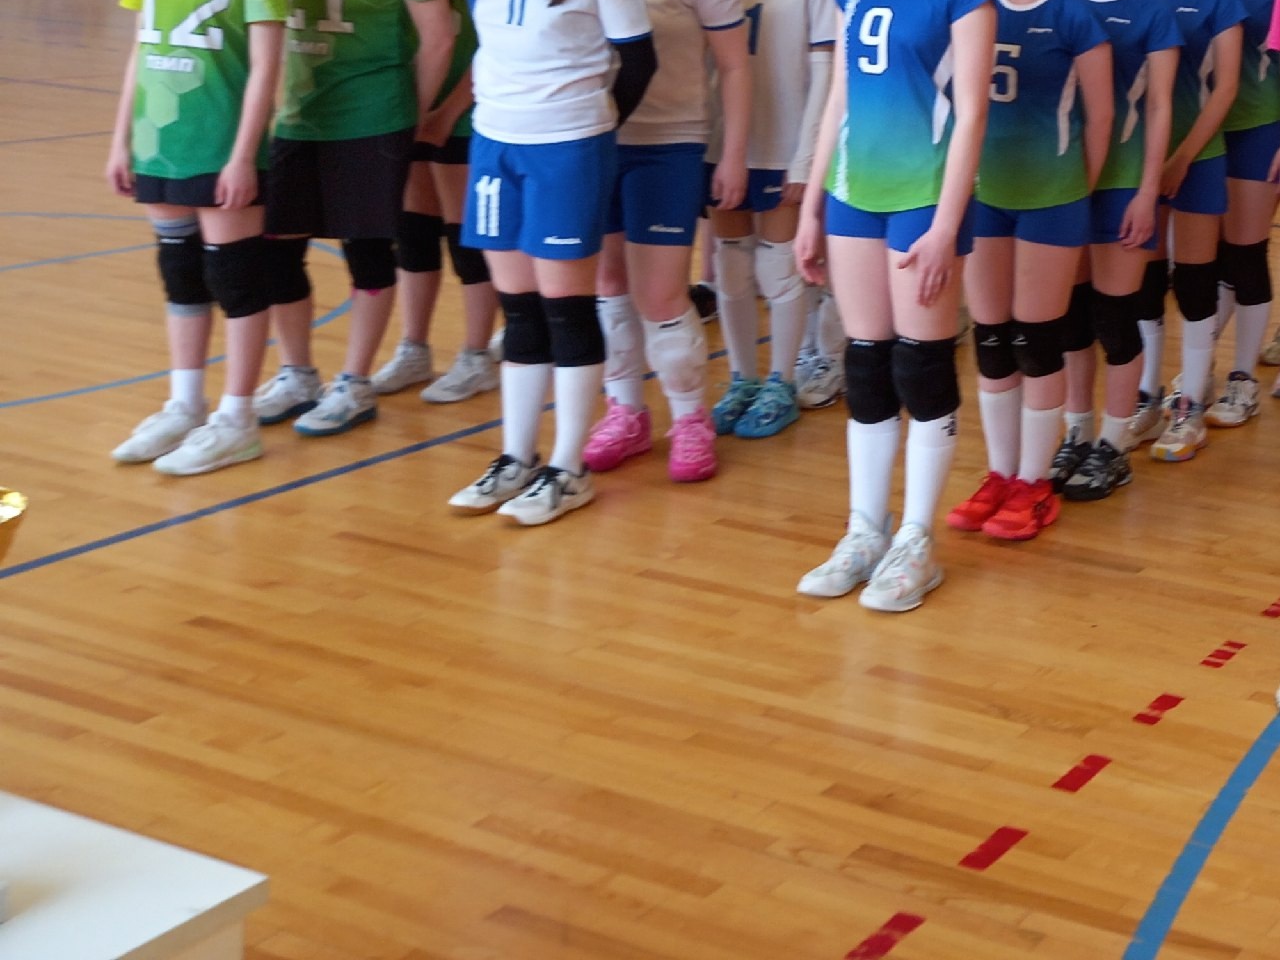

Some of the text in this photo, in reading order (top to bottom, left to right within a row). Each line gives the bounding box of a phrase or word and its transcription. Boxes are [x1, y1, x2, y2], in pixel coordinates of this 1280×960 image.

[858, 7, 894, 75] 9
[990, 43, 1022, 103] 5
[475, 175, 502, 237] 11
